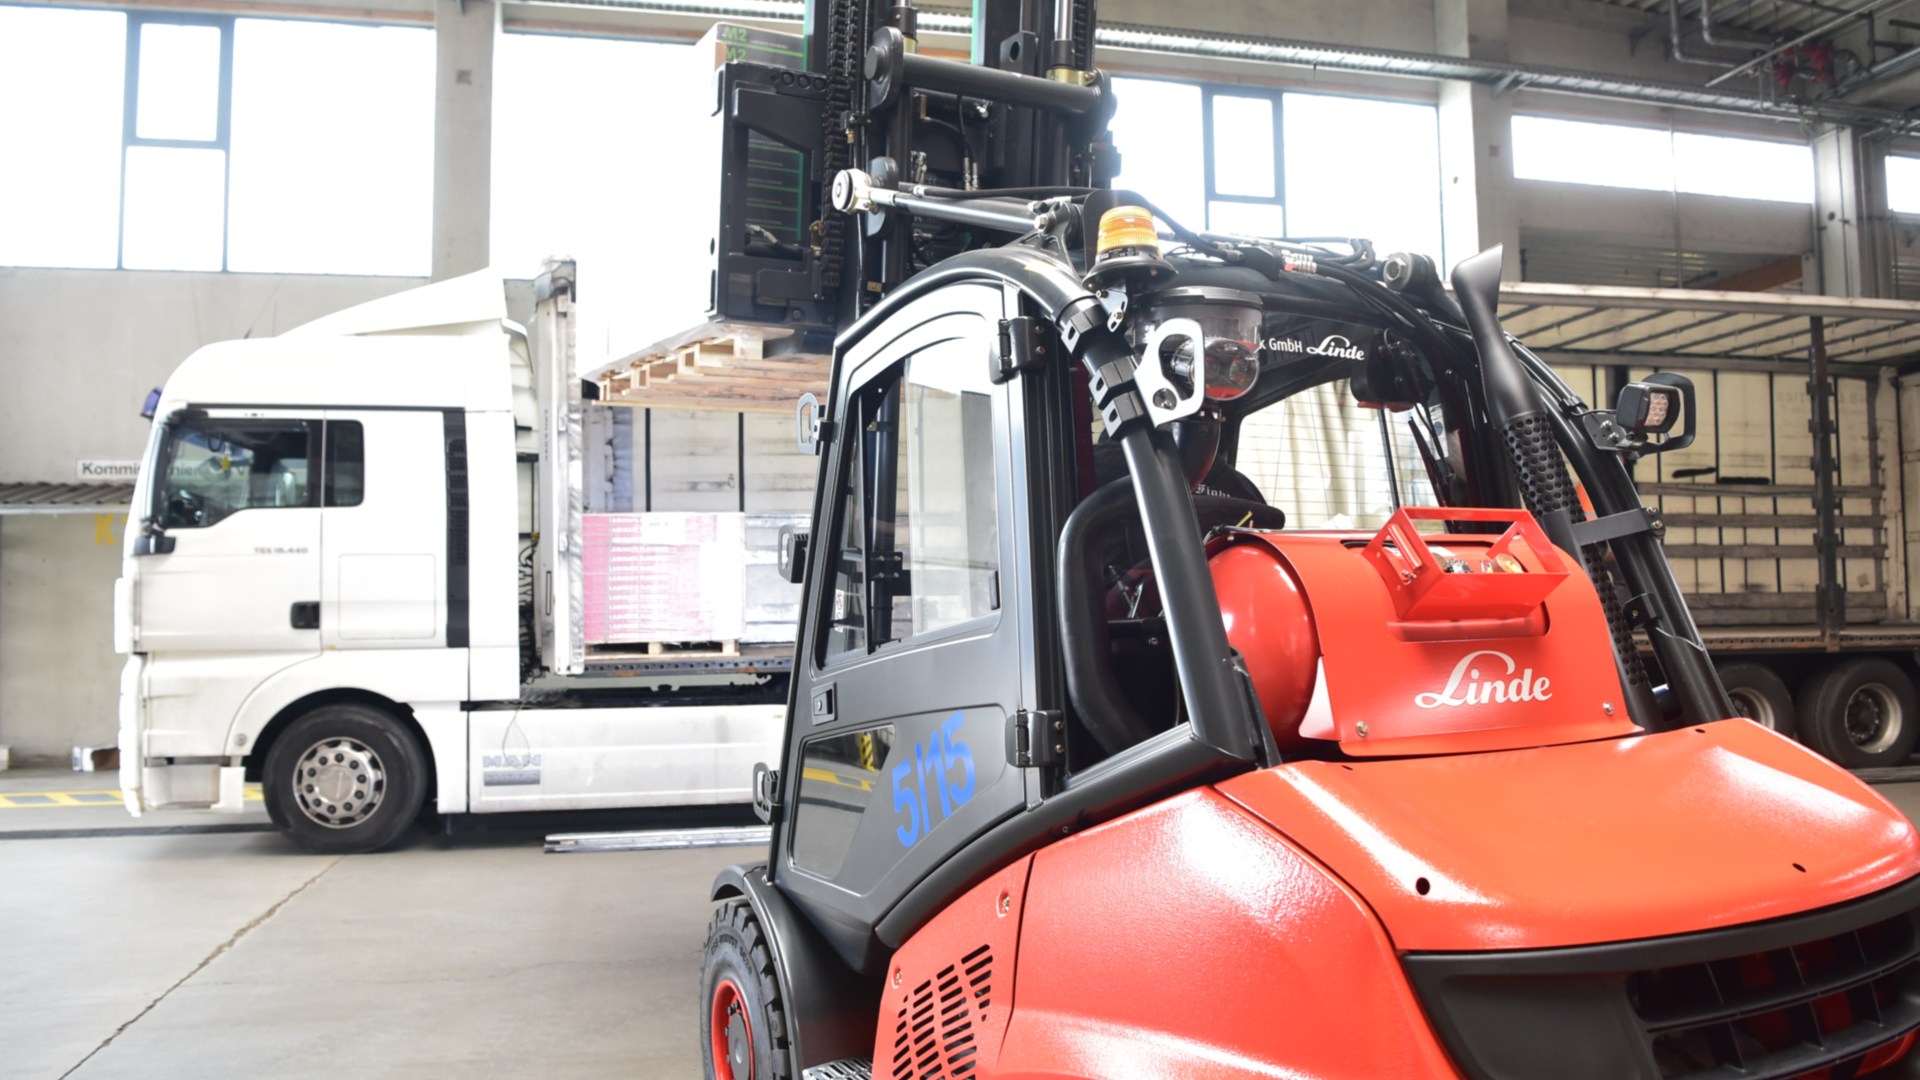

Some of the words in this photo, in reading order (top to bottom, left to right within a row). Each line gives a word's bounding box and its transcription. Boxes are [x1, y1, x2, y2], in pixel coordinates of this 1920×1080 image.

[723, 26, 748, 42] M2
[1268, 337, 1303, 353] GmbH
[1306, 334, 1366, 361] Linde
[1414, 650, 1553, 709] Linde
[482, 754, 542, 768] MAN
[892, 709, 976, 847] 5/15
